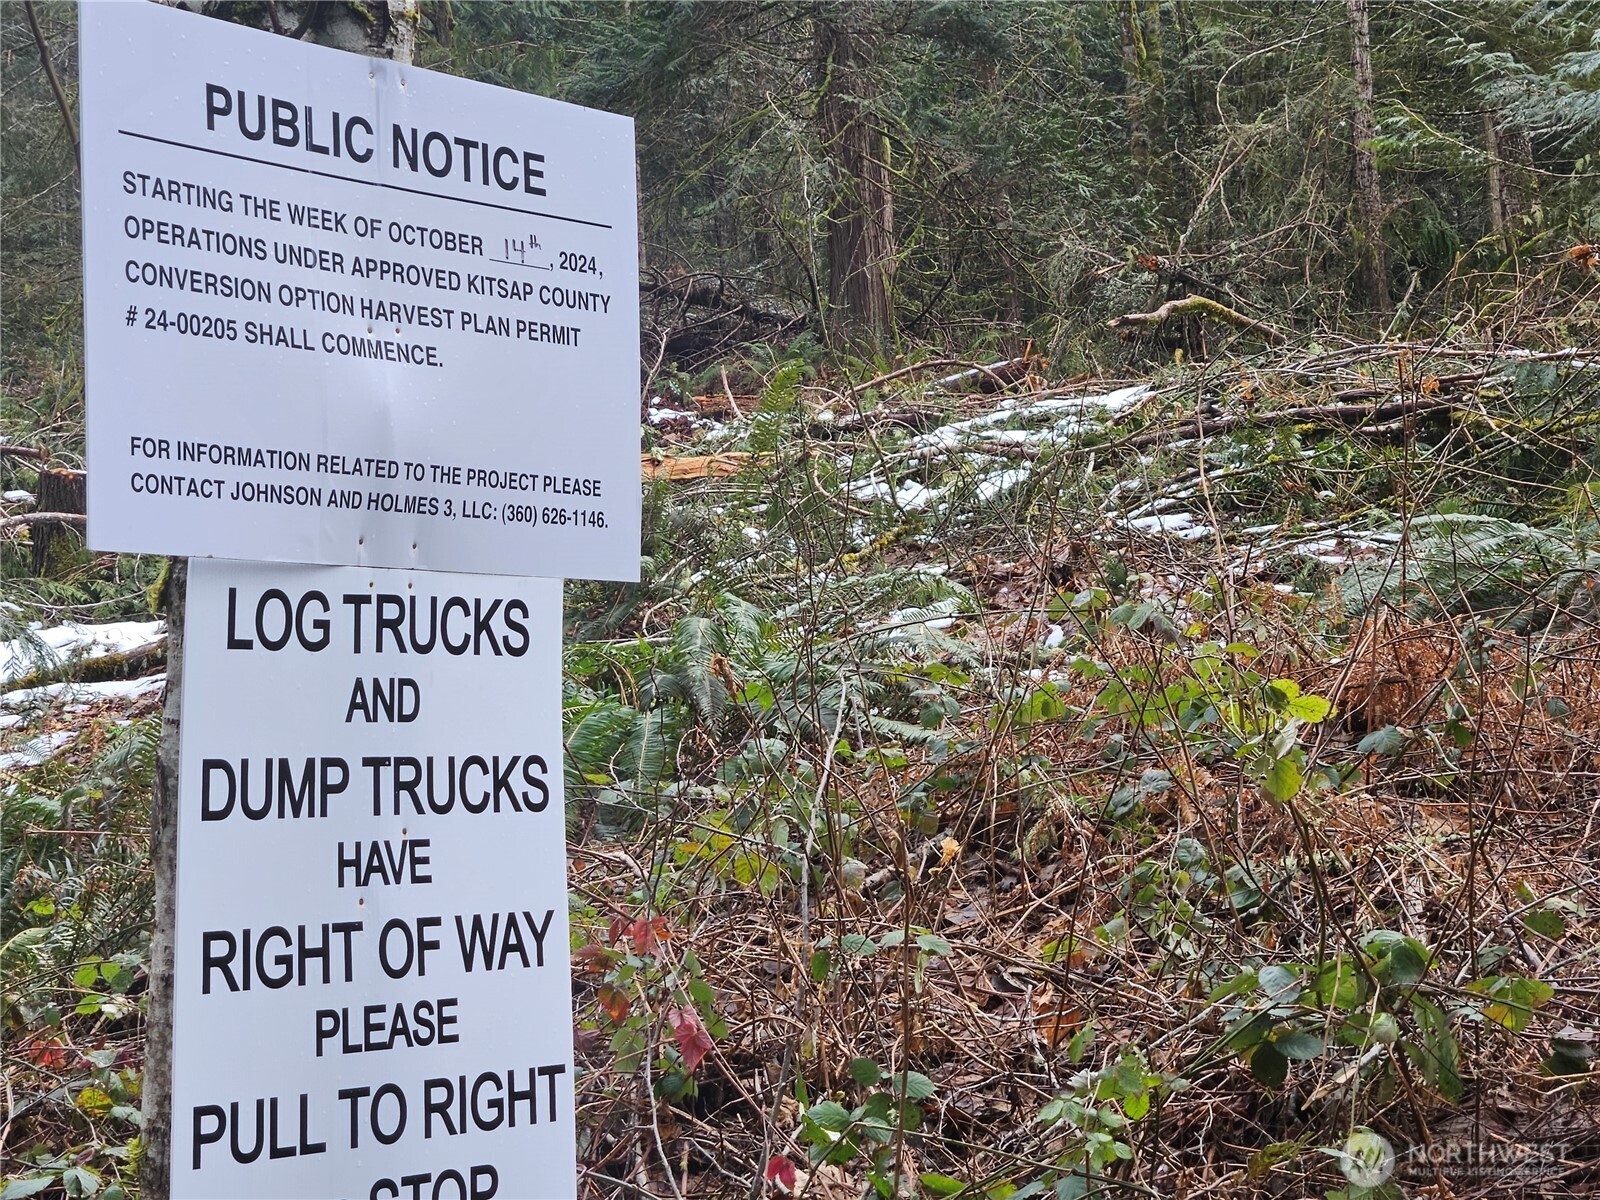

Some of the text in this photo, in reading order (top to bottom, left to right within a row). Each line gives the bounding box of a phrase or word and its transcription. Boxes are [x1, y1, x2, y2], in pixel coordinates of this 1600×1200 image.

[206, 83, 546, 197] PUBLIC NOTICE
[123, 171, 233, 213] STARTING
[239, 194, 281, 222] THE
[287, 202, 348, 234] WEEK
[354, 216, 382, 239] OF
[388, 220, 483, 256] OCTOBER
[559, 251, 603, 280] 2024,
[124, 215, 611, 314] OPERATIONS UNDER APPROVED KITSAP COUNTY
[125, 260, 581, 347] CONVERSION OPTION HARVEST PLAN PERMIT
[125, 305, 443, 367] # 24-00205 SHALL COMMENCE.
[131, 436, 601, 497] FOR INFORMATION RELATED TO THE PROJECT PLEASE
[131, 472, 608, 529] CONTACT JOHNSON AND HOLMES 3, LLC: (360) 626-1146.
[227, 587, 530, 657] LOG TRUCKS
[345, 677, 420, 723] AND
[201, 755, 549, 821] DUMP TRUCKS
[338, 839, 432, 888] HAVE
[202, 910, 555, 995] RIGHT OF WAY
[316, 997, 459, 1063] PLEASE
[192, 1064, 566, 1170] PULL TO RIGHT
